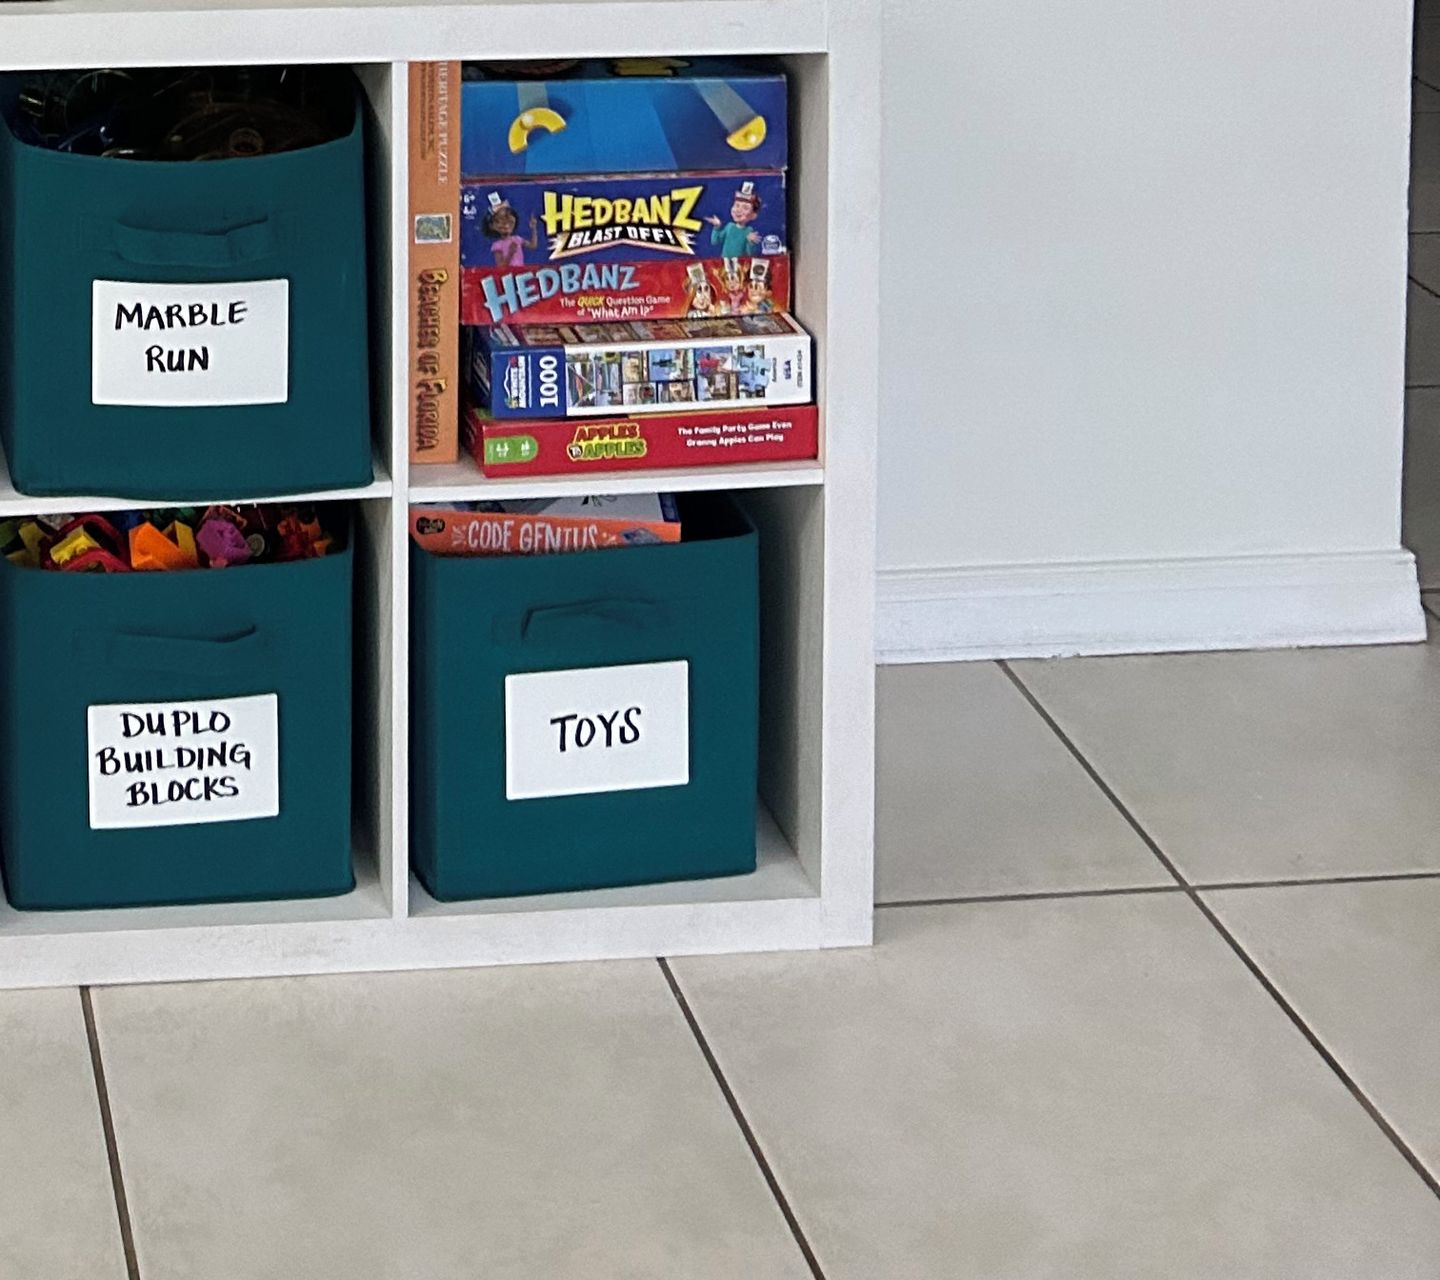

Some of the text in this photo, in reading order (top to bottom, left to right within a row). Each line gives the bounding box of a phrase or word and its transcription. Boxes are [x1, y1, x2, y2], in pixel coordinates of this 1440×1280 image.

[540, 185, 704, 237] HEDBANZ
[567, 226, 677, 249] BLAST OFF!
[481, 264, 641, 323] HEDBANZ
[560, 295, 671, 308] The QUICK Question Game
[114, 300, 249, 331] MARBLE
[621, 306, 638, 318] Am
[144, 344, 210, 373] RUN
[416, 268, 449, 452] BEACHES OF FLORIDA
[539, 355, 559, 408] 1000
[574, 424, 638, 441] APPLES
[678, 420, 792, 435] The Family Party Game Even
[686, 433, 784, 447] Granny Apples Can Play
[582, 440, 646, 458] APPLES
[120, 710, 231, 738] DUPLO
[550, 706, 642, 753] TOYS
[95, 741, 252, 775] BUILDING
[125, 776, 240, 808] BLOCKS
